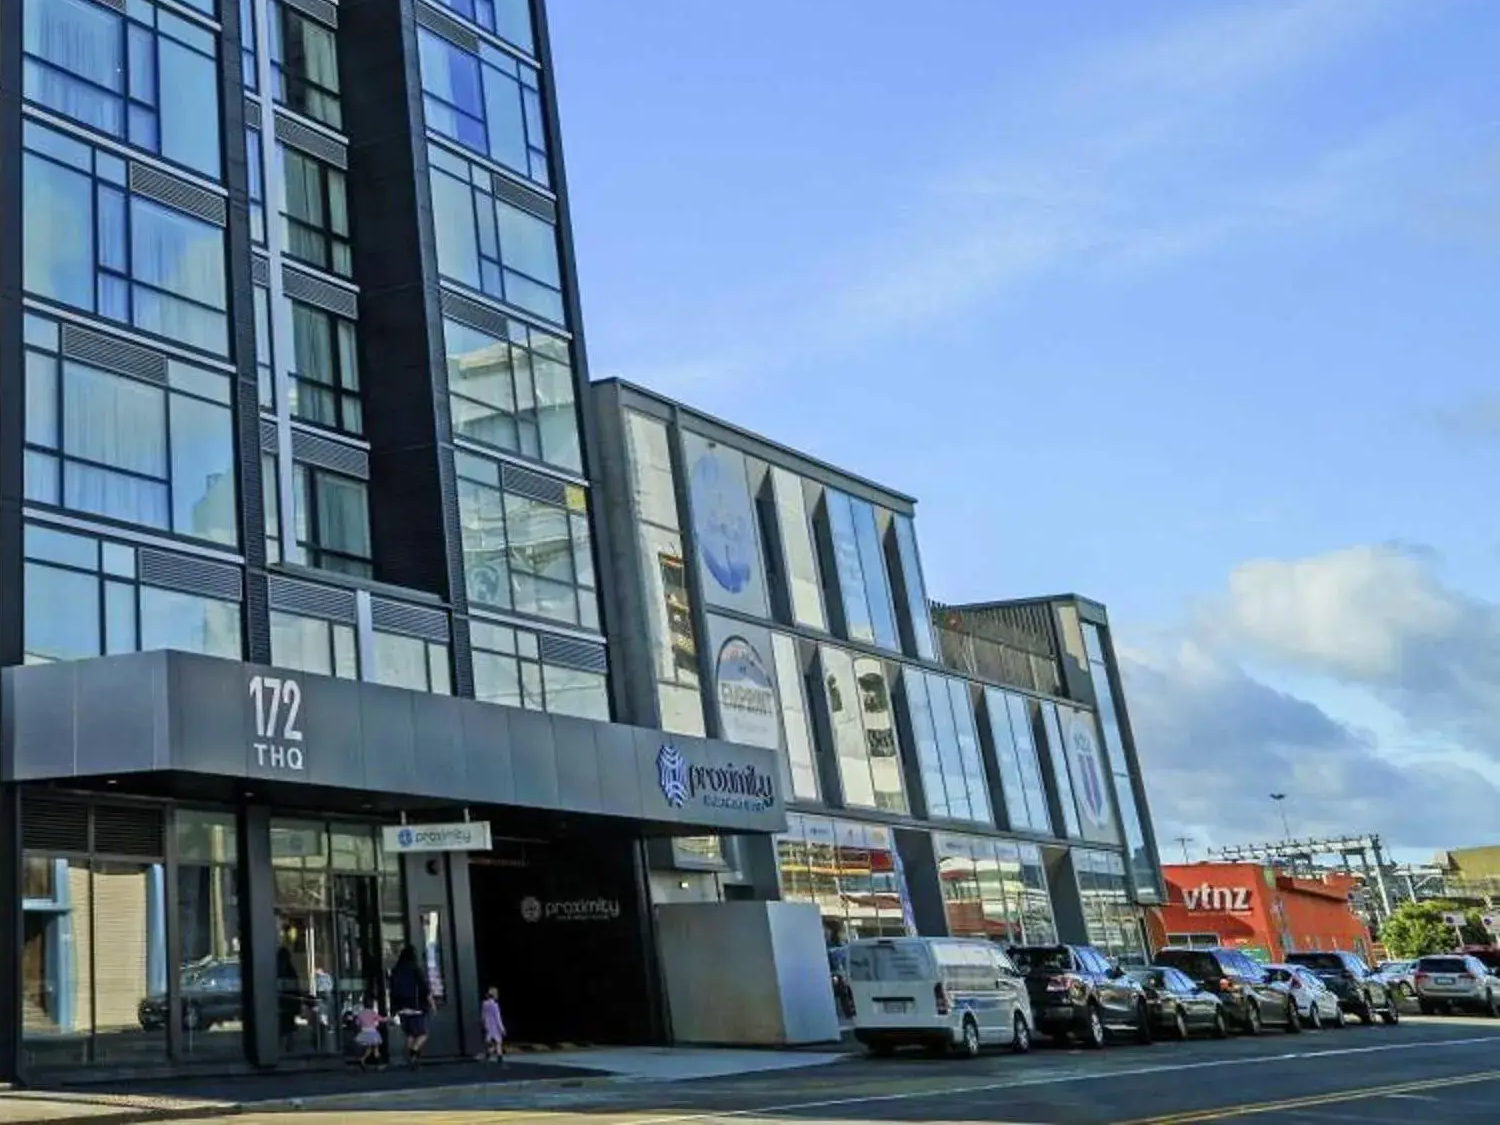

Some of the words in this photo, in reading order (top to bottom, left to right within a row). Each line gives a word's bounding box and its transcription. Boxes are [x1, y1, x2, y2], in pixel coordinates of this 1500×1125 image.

[249, 676, 303, 741] 172
[253, 743, 303, 770] THQ
[688, 762, 774, 808] proximity
[1182, 882, 1250, 910] vtnz
